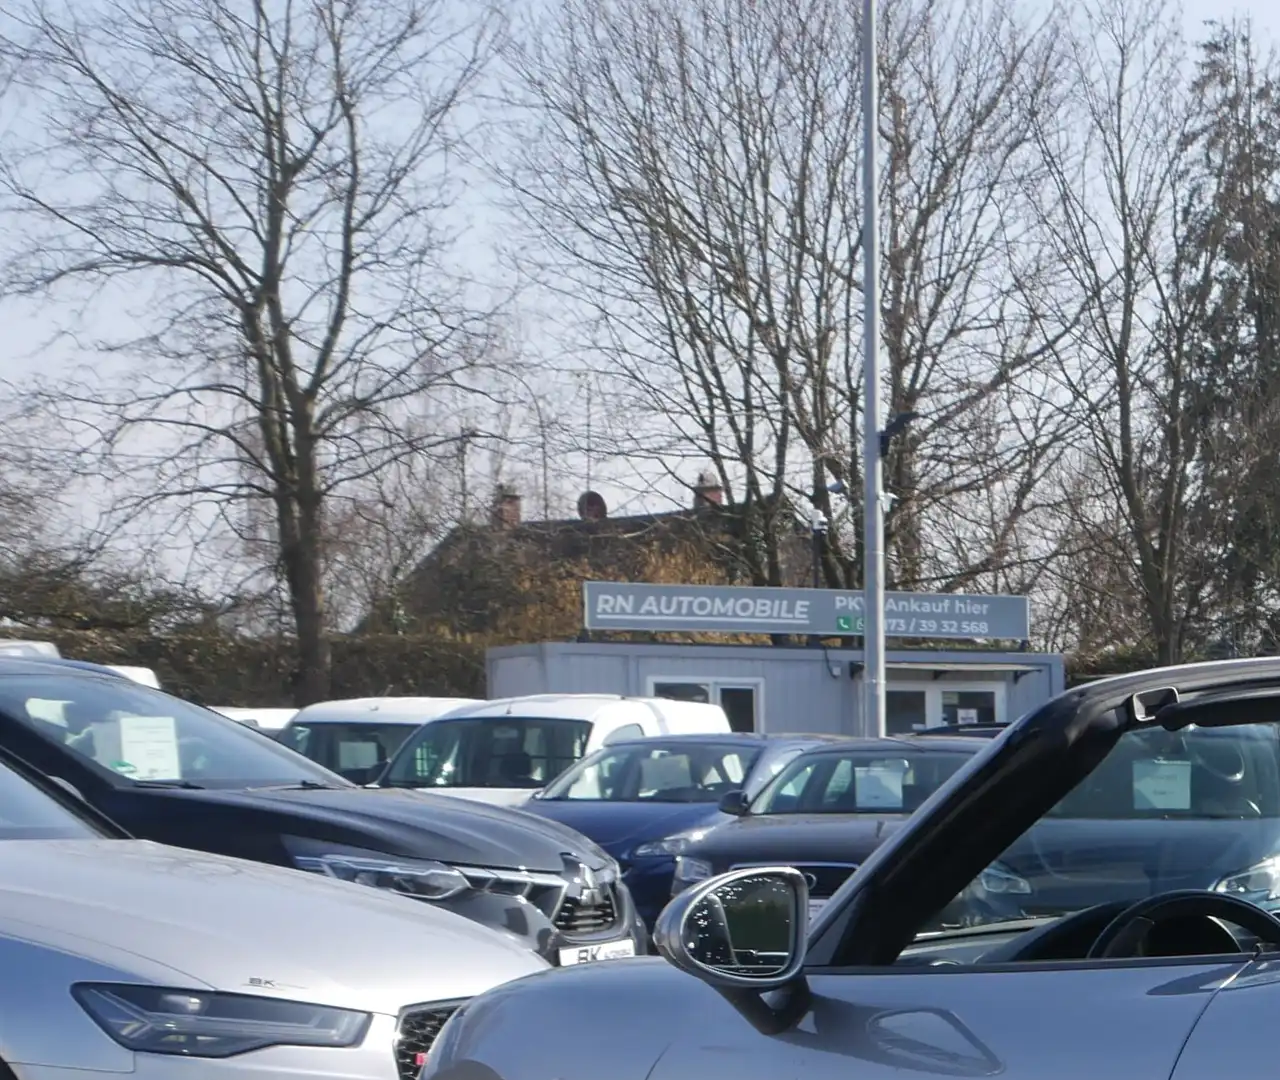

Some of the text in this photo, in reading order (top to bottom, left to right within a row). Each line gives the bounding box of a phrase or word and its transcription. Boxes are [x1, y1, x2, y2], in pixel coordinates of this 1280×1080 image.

[597, 595, 810, 619] RN AUTOMOBILE
[835, 596, 864, 611] PK
[955, 599, 990, 615] hier
[884, 619, 906, 632] 173
[919, 620, 937, 632] 39
[941, 620, 958, 633] 32
[961, 621, 988, 634] 568
[577, 946, 601, 964] BK
